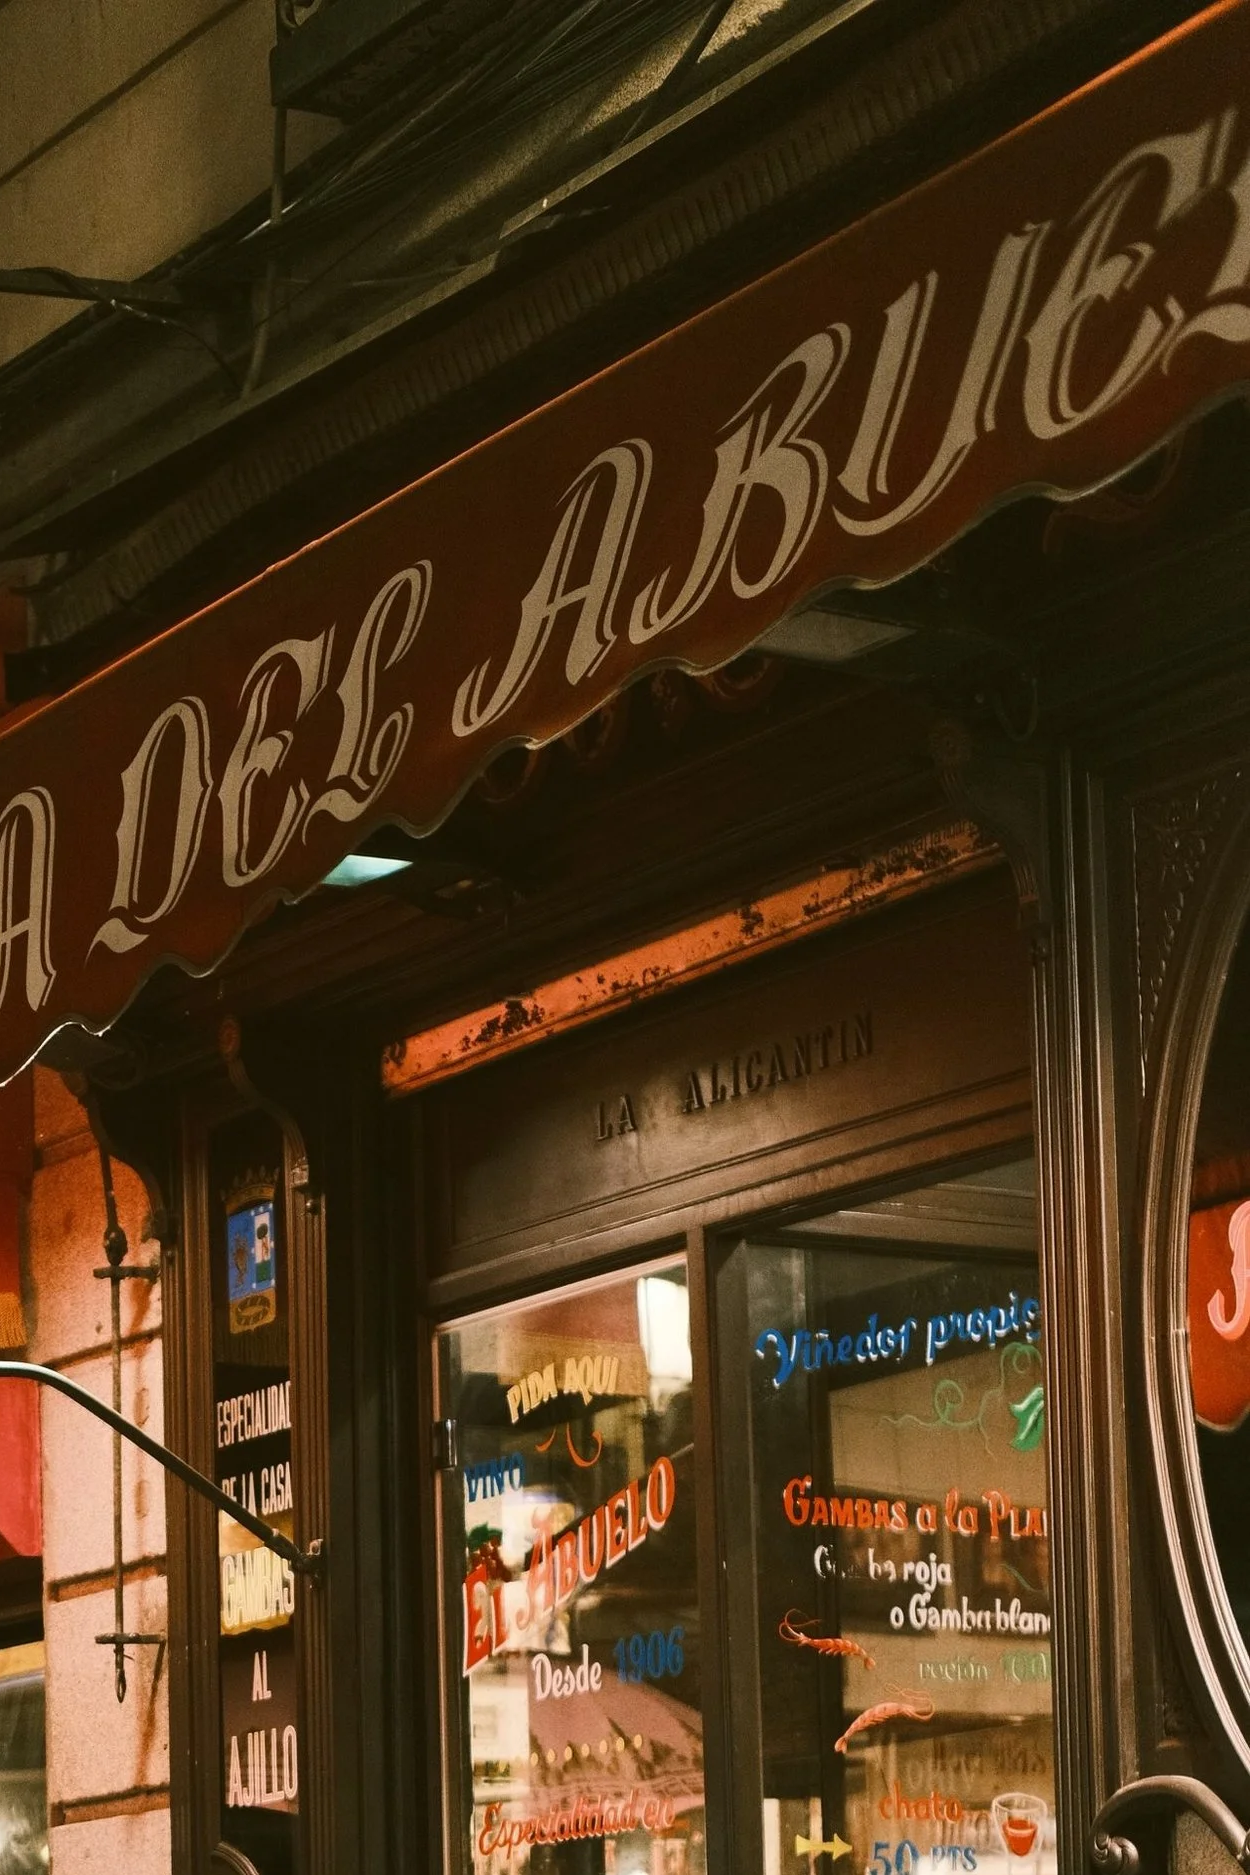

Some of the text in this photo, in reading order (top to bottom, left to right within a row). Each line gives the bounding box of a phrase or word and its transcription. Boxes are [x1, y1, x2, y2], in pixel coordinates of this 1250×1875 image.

[83, 558, 433, 965] DEL
[596, 1093, 637, 1141] LA
[507, 1355, 619, 1425] PIDA AQUI
[261, 1461, 294, 1516] CASA
[464, 1451, 525, 1503] VINO
[783, 1475, 1048, 1541] GAMBAS a la PLA
[516, 1456, 676, 1631] ABUELO
[903, 1552, 953, 1592] roja
[222, 1546, 295, 1626] GAMBAS
[889, 1606, 905, 1630] o
[995, 1597, 1050, 1635] blan
[252, 1650, 272, 1701] AL
[531, 1625, 685, 1701] Desde 1906
[227, 1724, 299, 1808] AJILLO
[479, 1788, 639, 1859] Especialidad
[879, 1780, 964, 1824] chato
